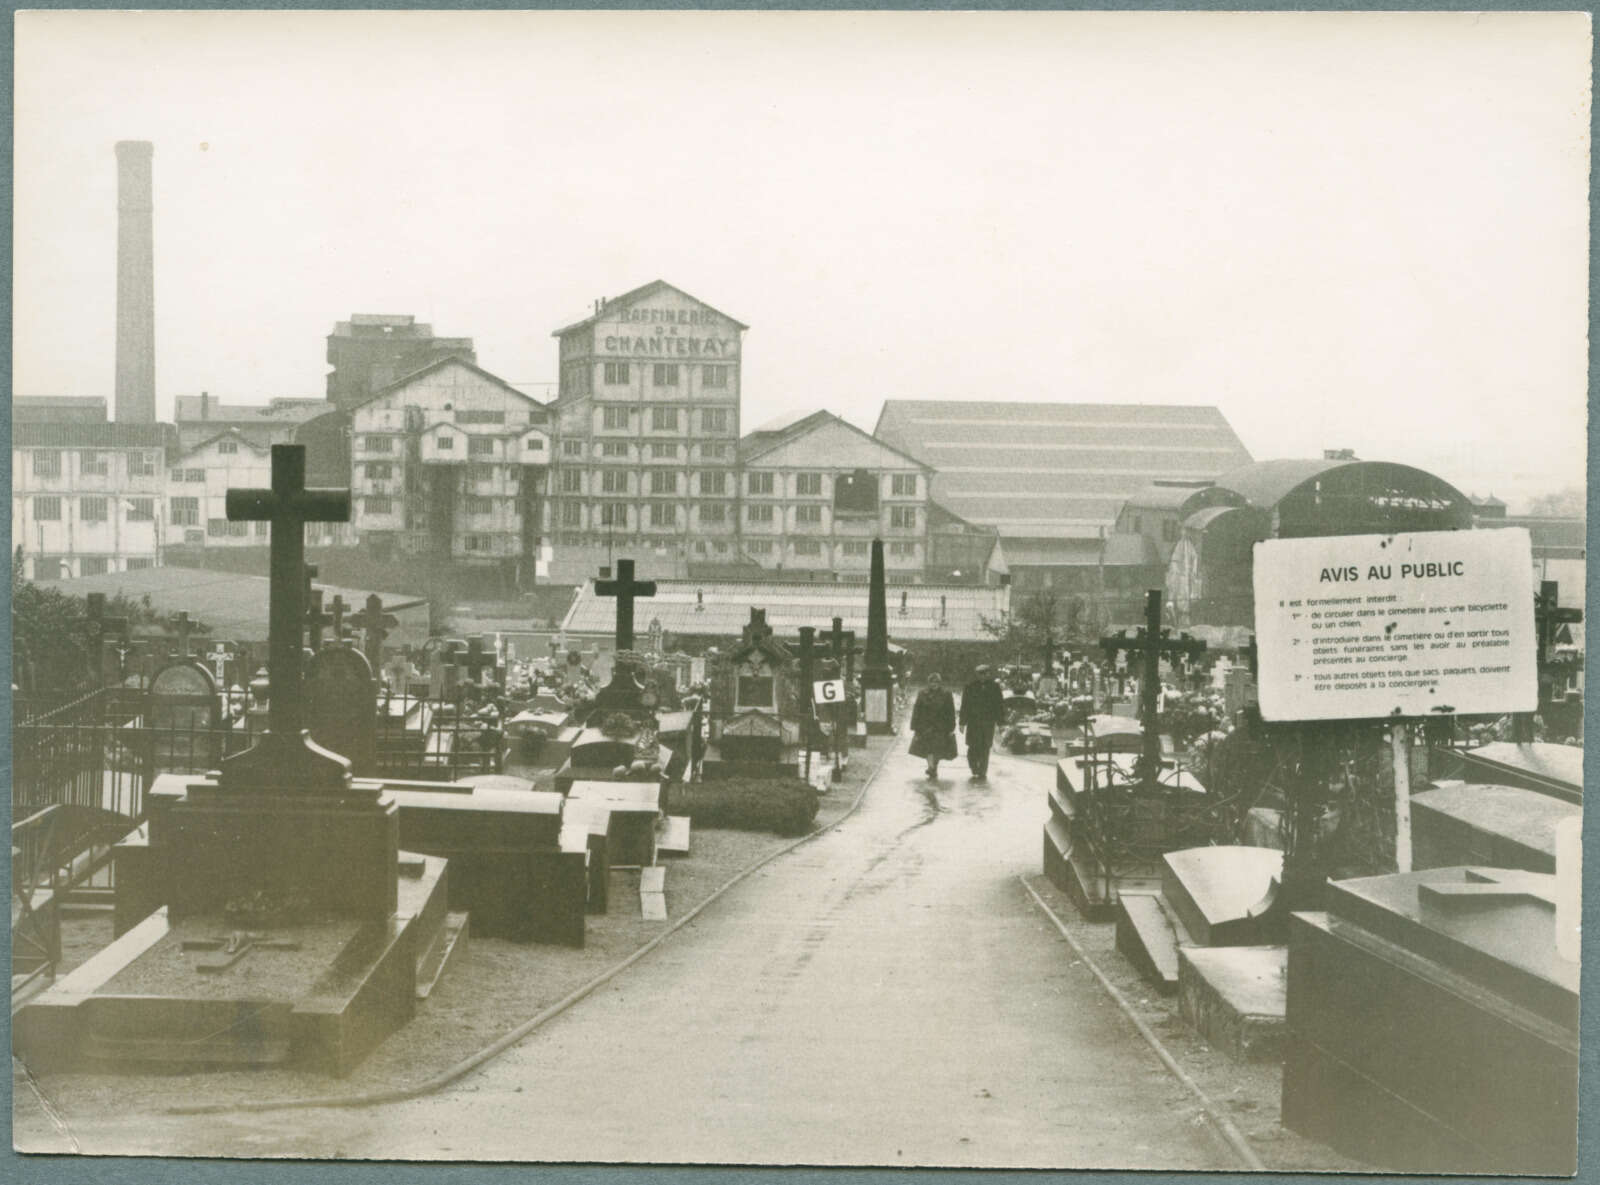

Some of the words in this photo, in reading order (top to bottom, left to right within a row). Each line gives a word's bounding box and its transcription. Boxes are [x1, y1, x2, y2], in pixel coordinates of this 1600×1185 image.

[655, 326, 678, 336] DE
[605, 336, 729, 354] CHANTENAY
[1319, 566, 1359, 583] AVIS
[1367, 564, 1392, 581] AU
[1401, 561, 1465, 580] PUBLIC
[822, 681, 836, 700] G
